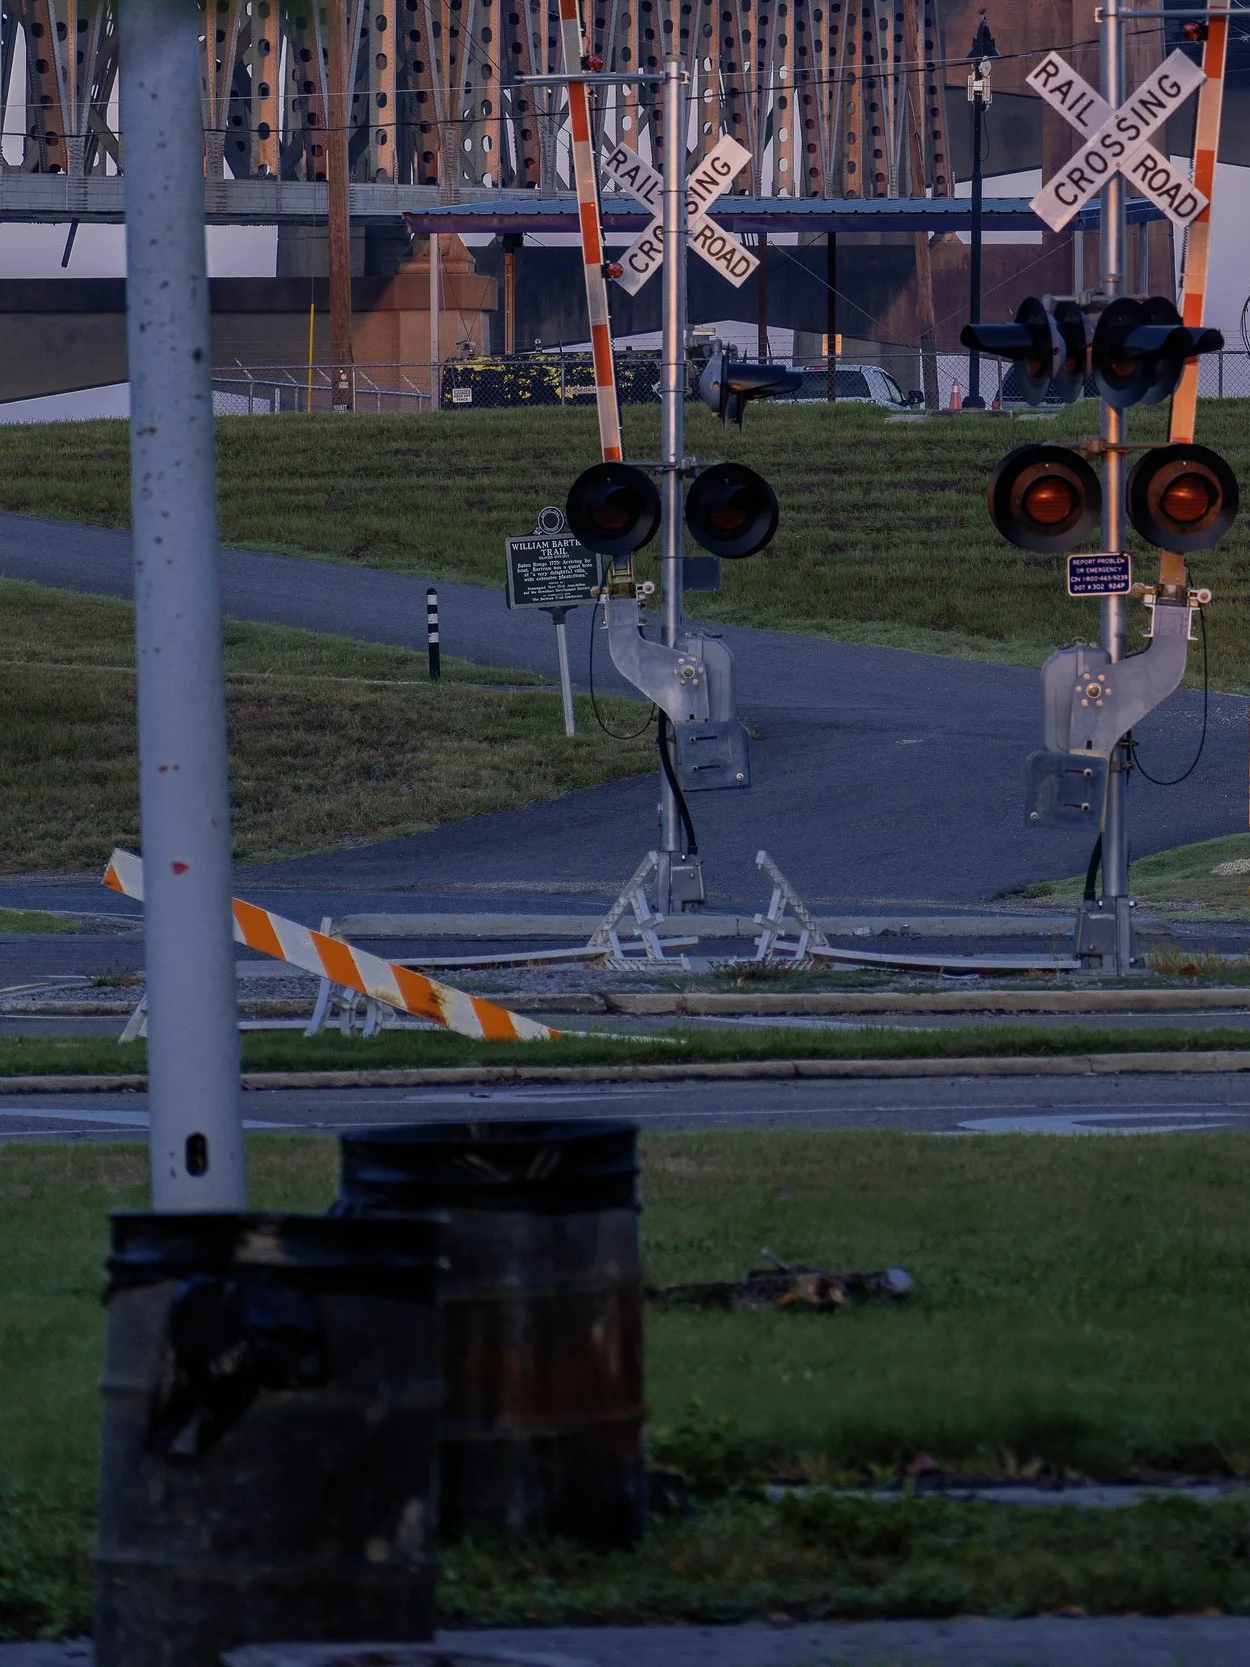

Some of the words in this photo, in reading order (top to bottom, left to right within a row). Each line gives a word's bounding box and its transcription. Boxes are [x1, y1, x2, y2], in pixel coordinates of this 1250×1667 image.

[1034, 59, 1095, 127] RAIL
[1131, 153, 1198, 219] ROAD
[1054, 74, 1182, 206] CROSSING
[606, 149, 659, 205] RAIL
[693, 224, 751, 278] ROAD
[628, 156, 732, 274] CROSING
[511, 541, 549, 551] WILLIAM
[552, 539, 581, 548] BARTR
[540, 548, 568, 556] TRAIL
